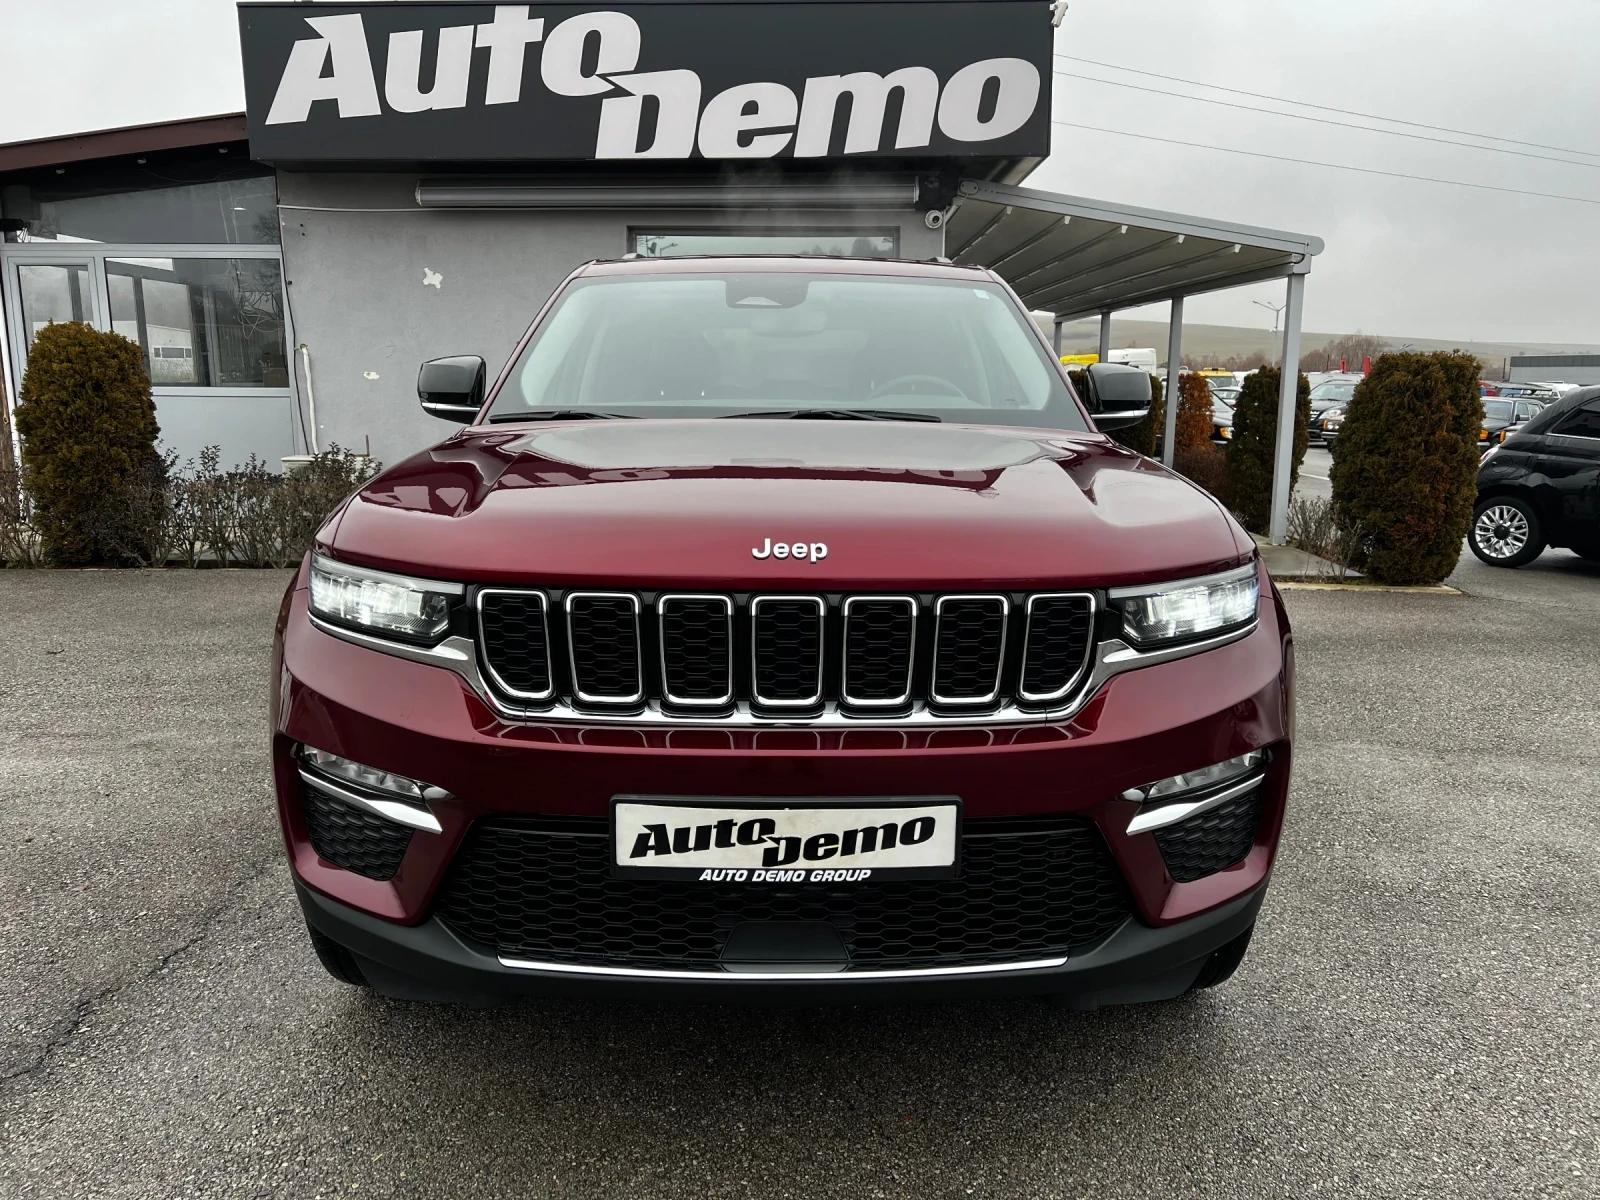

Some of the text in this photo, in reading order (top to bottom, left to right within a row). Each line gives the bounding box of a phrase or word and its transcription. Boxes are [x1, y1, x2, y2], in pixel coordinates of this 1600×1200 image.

[265, 5, 1041, 159] Auto Demo
[751, 537, 828, 564] Jeep
[629, 816, 936, 867] Auto Demo
[699, 869, 871, 882] AUTO DEMO GROUP
